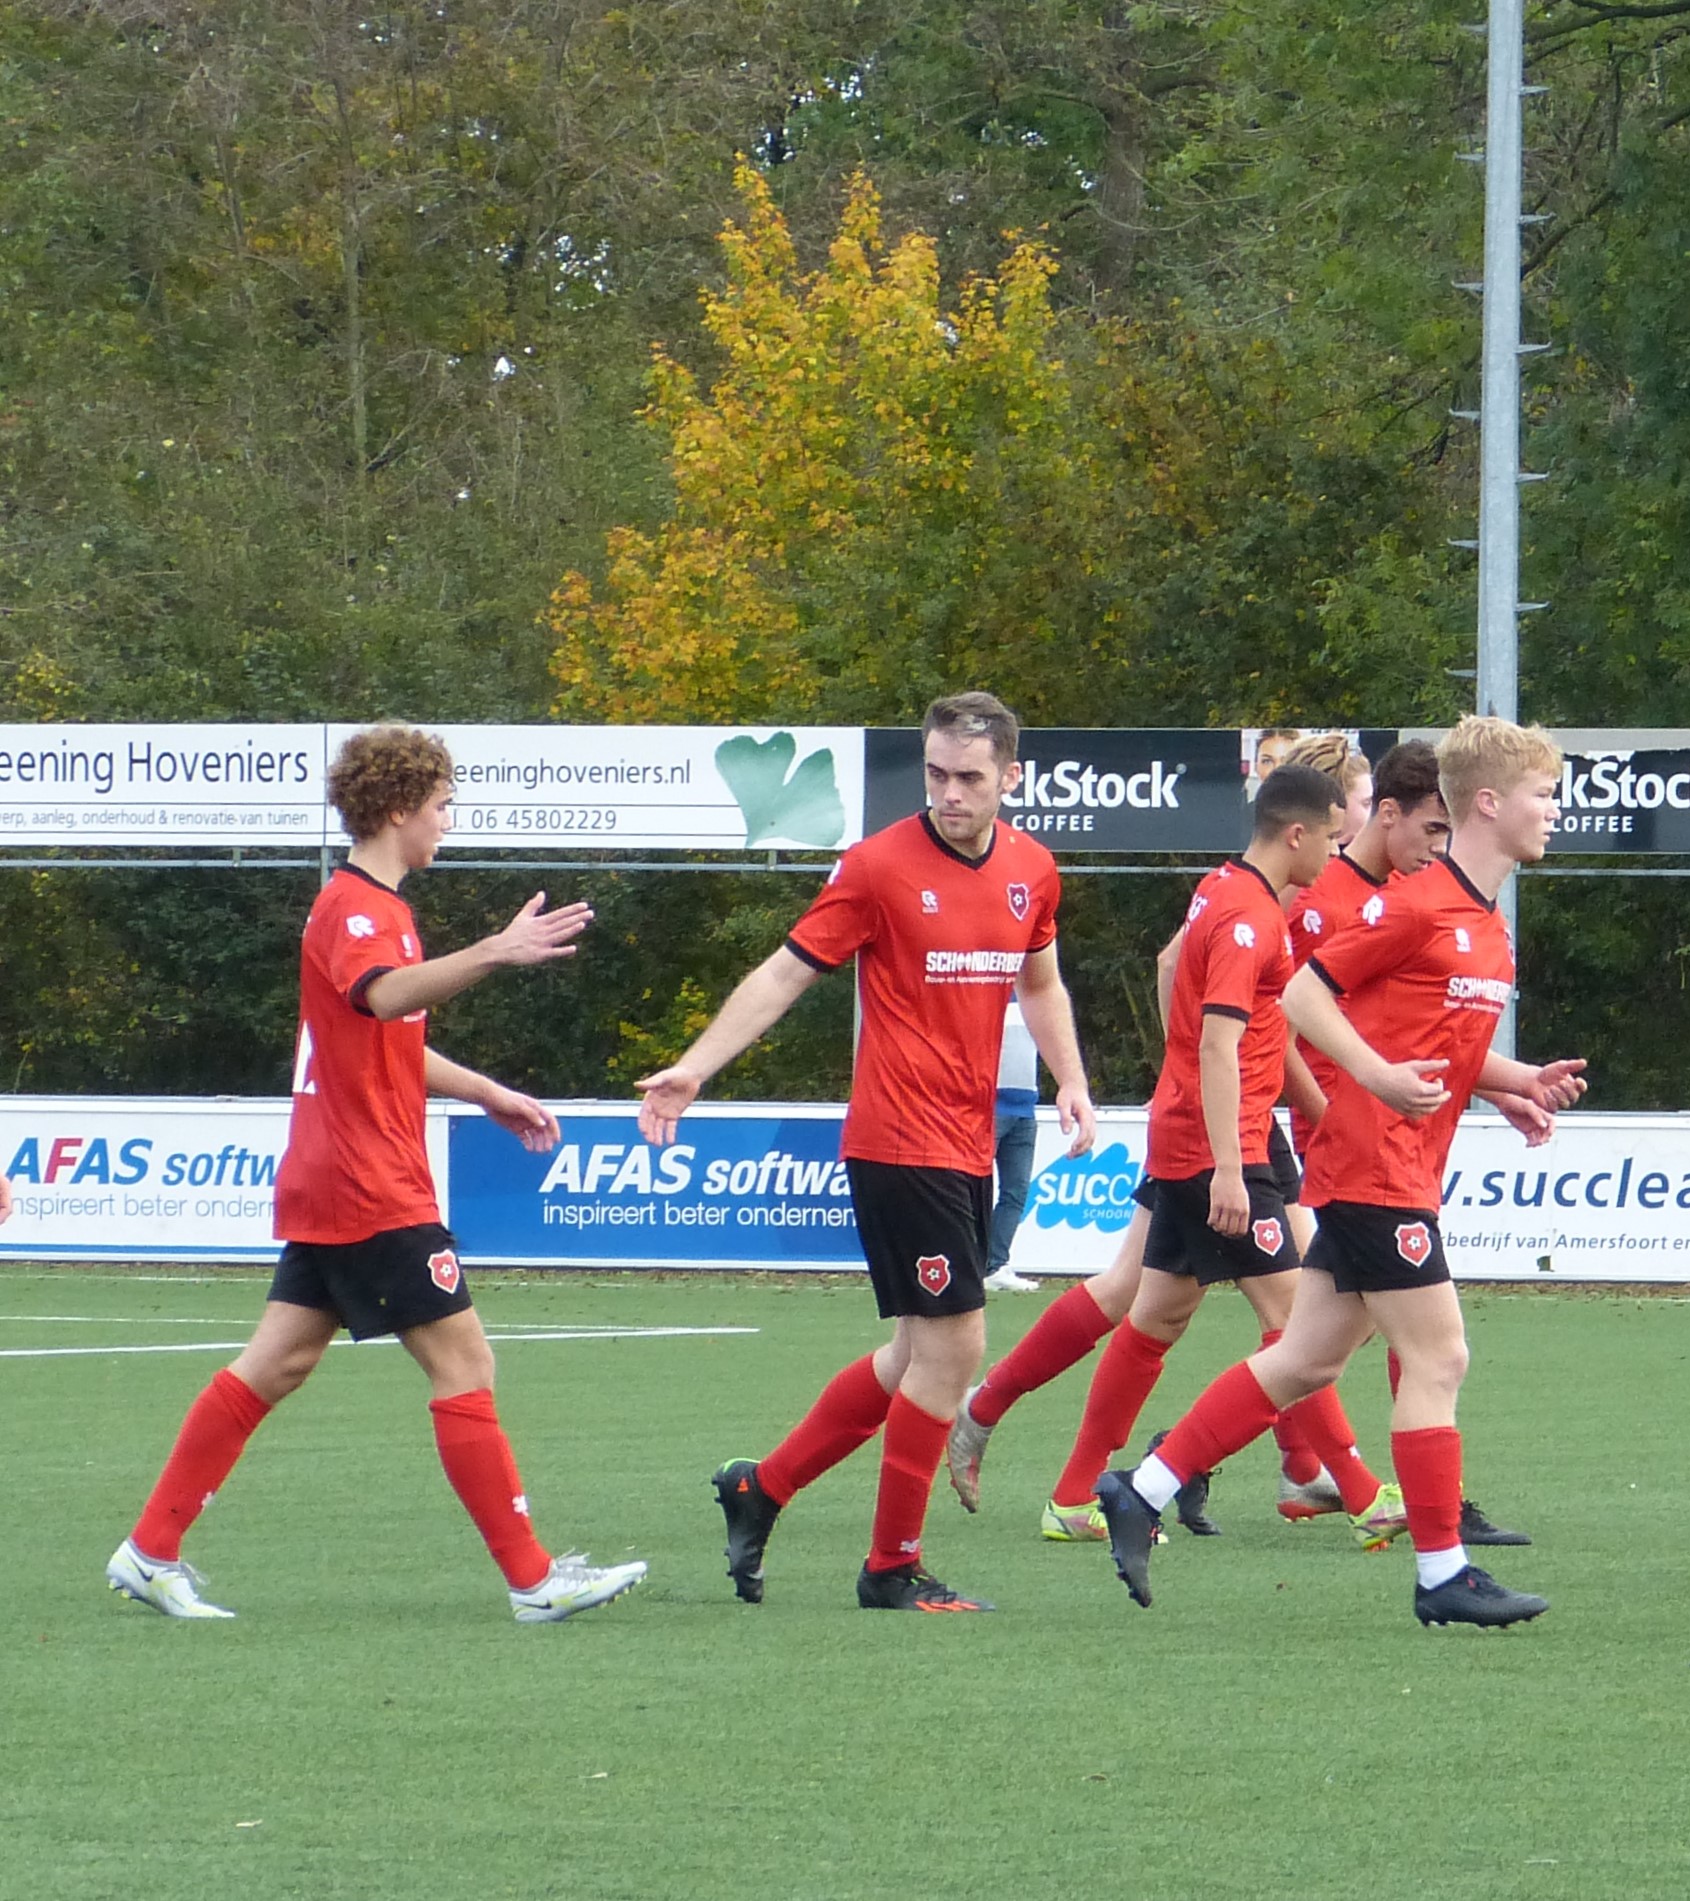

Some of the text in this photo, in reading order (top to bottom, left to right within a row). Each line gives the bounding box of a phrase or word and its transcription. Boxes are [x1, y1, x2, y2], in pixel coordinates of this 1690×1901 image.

[128, 740, 308, 784] Hoveniers
[454, 758, 690, 790] eeninghoveniers.nl
[32, 809, 78, 829] aanleg,
[82, 809, 155, 826] onderhoud
[158, 810, 168, 826] &
[239, 814, 263, 826] van
[267, 811, 308, 826] tuinen
[471, 809, 498, 829] 06
[506, 809, 617, 830] 45802229
[1011, 814, 1094, 832] COFFEE
[5, 1137, 276, 1187] AFAS softw
[538, 1144, 852, 1196] AFAS softwa
[11, 1192, 274, 1220] nspireert beter onder
[543, 1199, 657, 1230] inspireert
[664, 1200, 727, 1226] beter
[1082, 1208, 1132, 1219] SCHOON
[1442, 1231, 1512, 1252] bedrijf
[1516, 1236, 1549, 1249] van
[1555, 1233, 1668, 1250] Amersfoort
